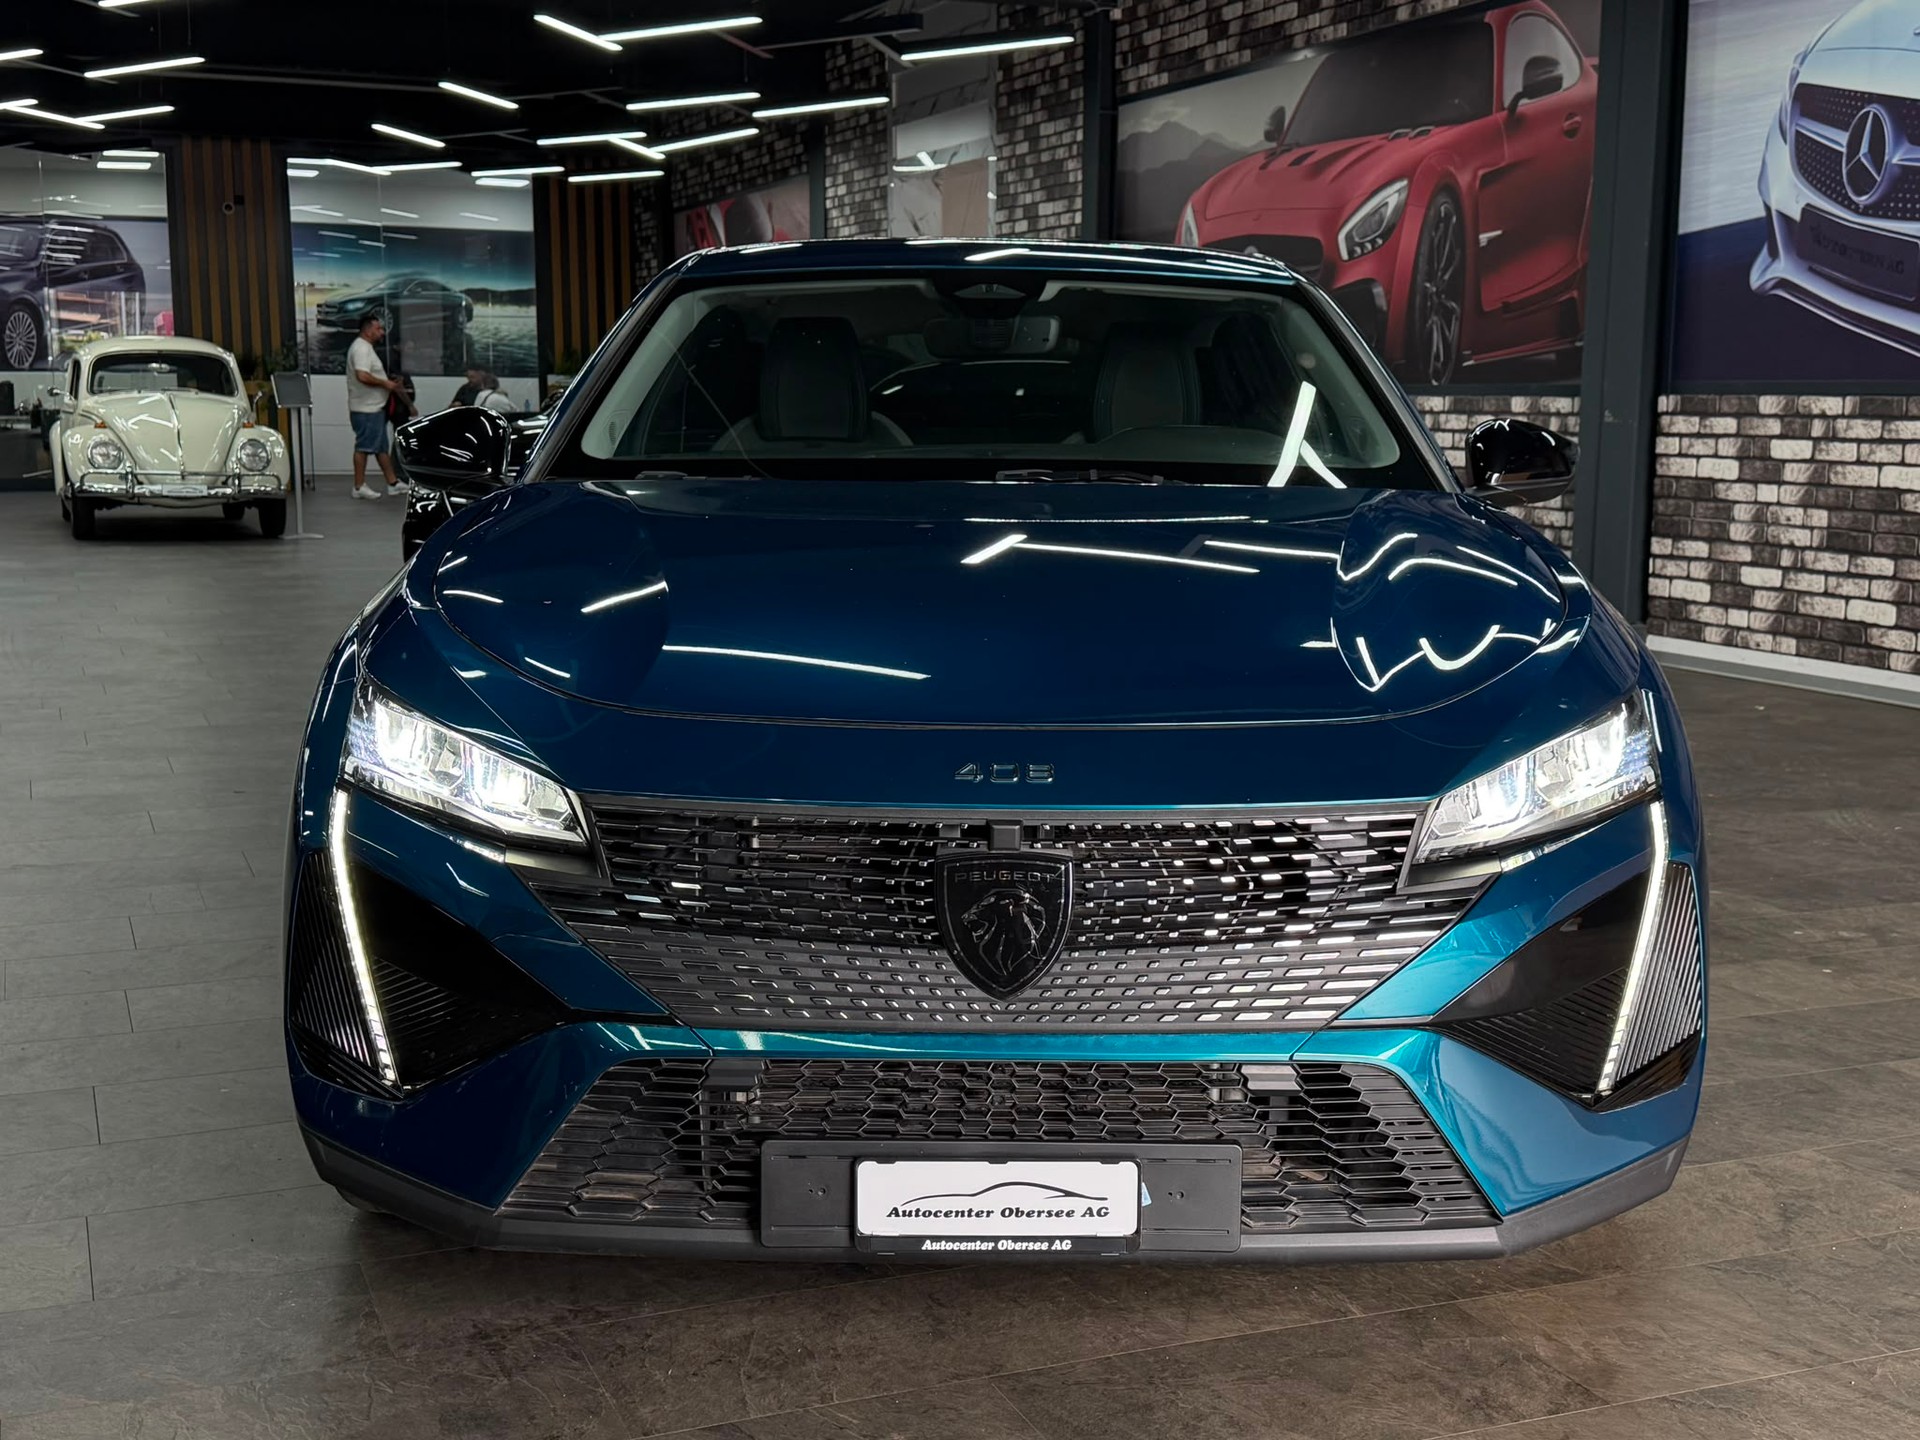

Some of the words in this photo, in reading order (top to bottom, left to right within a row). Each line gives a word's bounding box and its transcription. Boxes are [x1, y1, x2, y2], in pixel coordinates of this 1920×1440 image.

[954, 763, 1055, 783] 408
[955, 870, 1055, 882] PEUGEOT
[886, 1207, 995, 1218] Autocenter
[1000, 1206, 1076, 1218] Obersee
[1080, 1206, 1110, 1218] AG
[921, 1239, 995, 1251] Autocenter
[997, 1239, 1050, 1251] Obersee
[1050, 1239, 1073, 1251] AG
